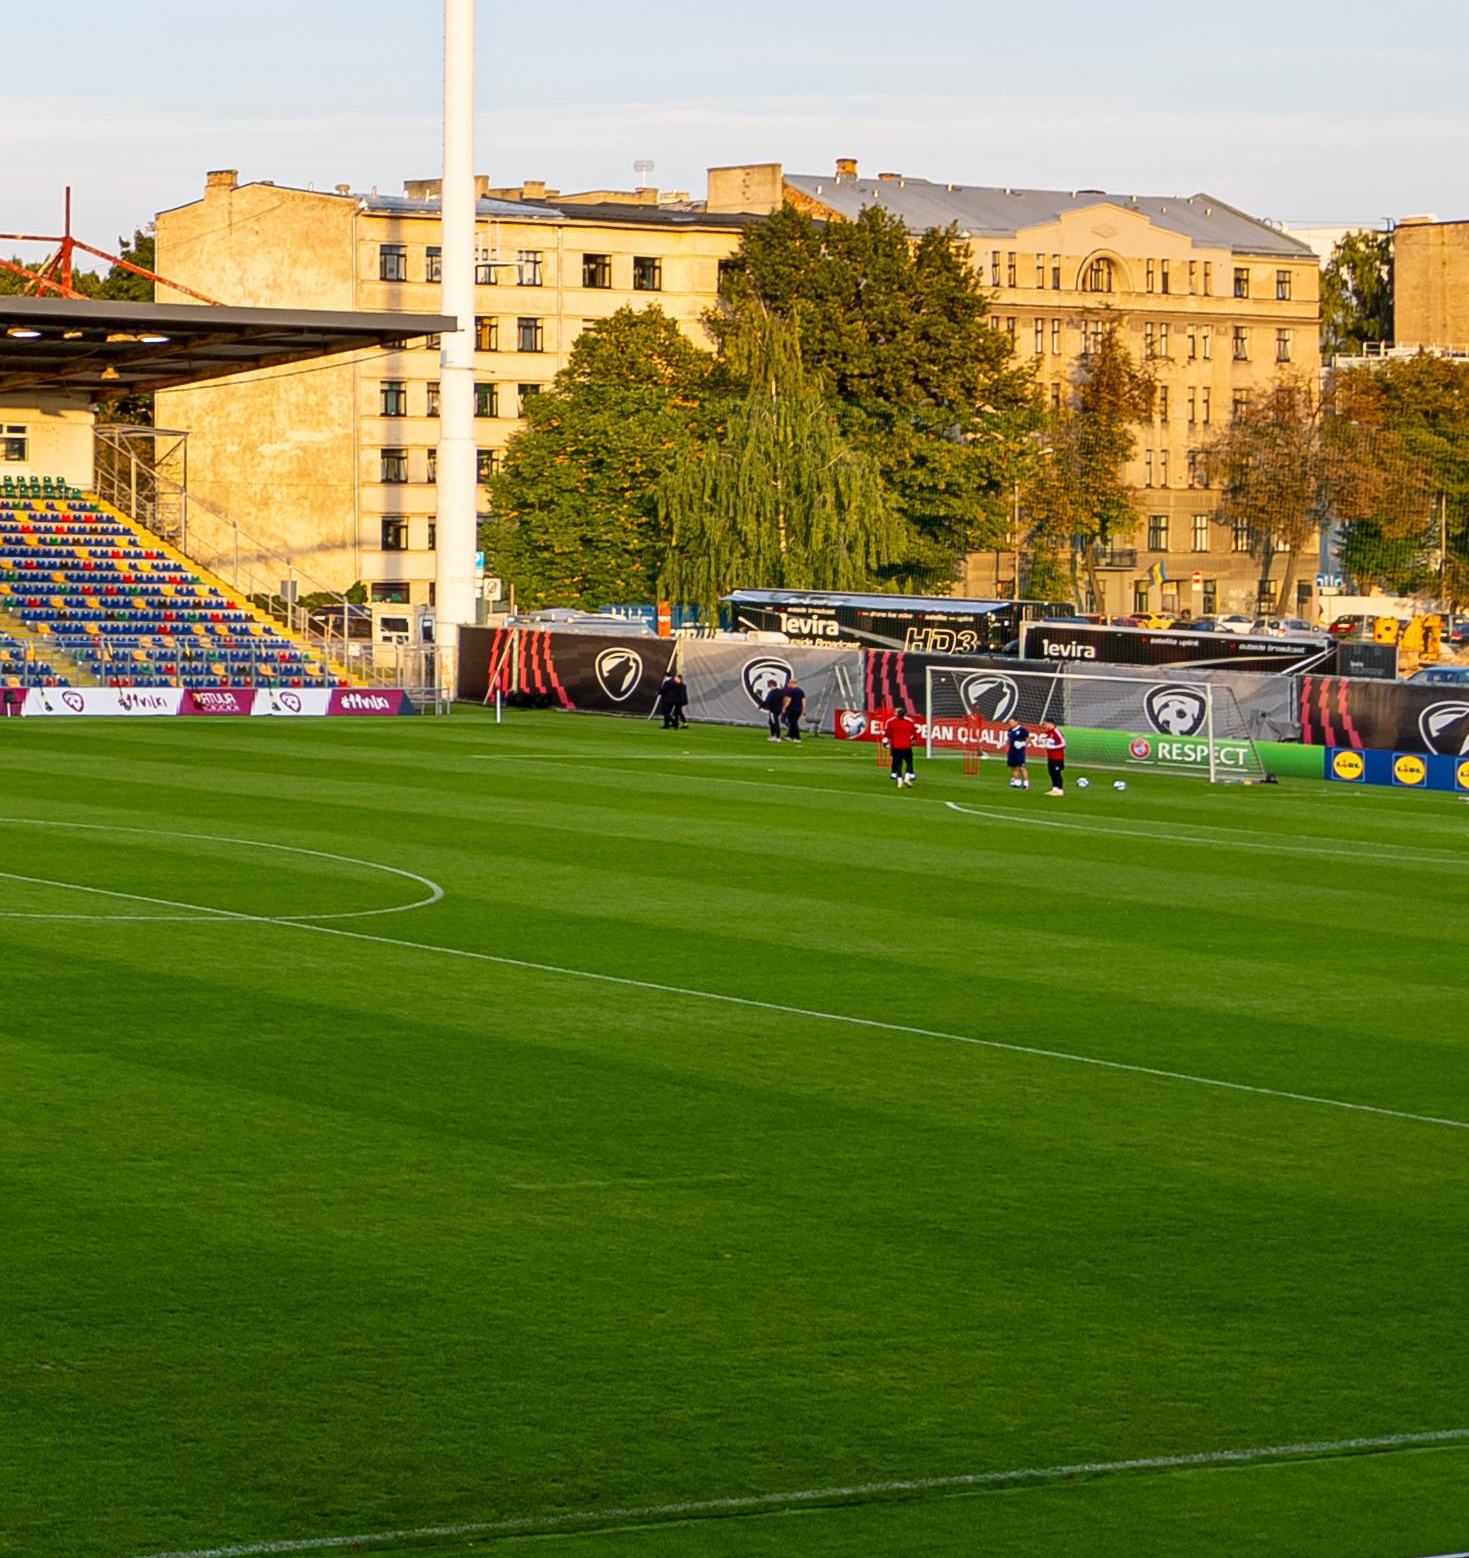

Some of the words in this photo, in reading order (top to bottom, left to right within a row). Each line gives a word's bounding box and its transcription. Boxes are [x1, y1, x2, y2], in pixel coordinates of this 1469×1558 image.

[780, 613, 839, 636] levira
[904, 627, 978, 654] HD3
[1042, 639, 1096, 659] levira
[1157, 743, 1248, 765] RESPECT
